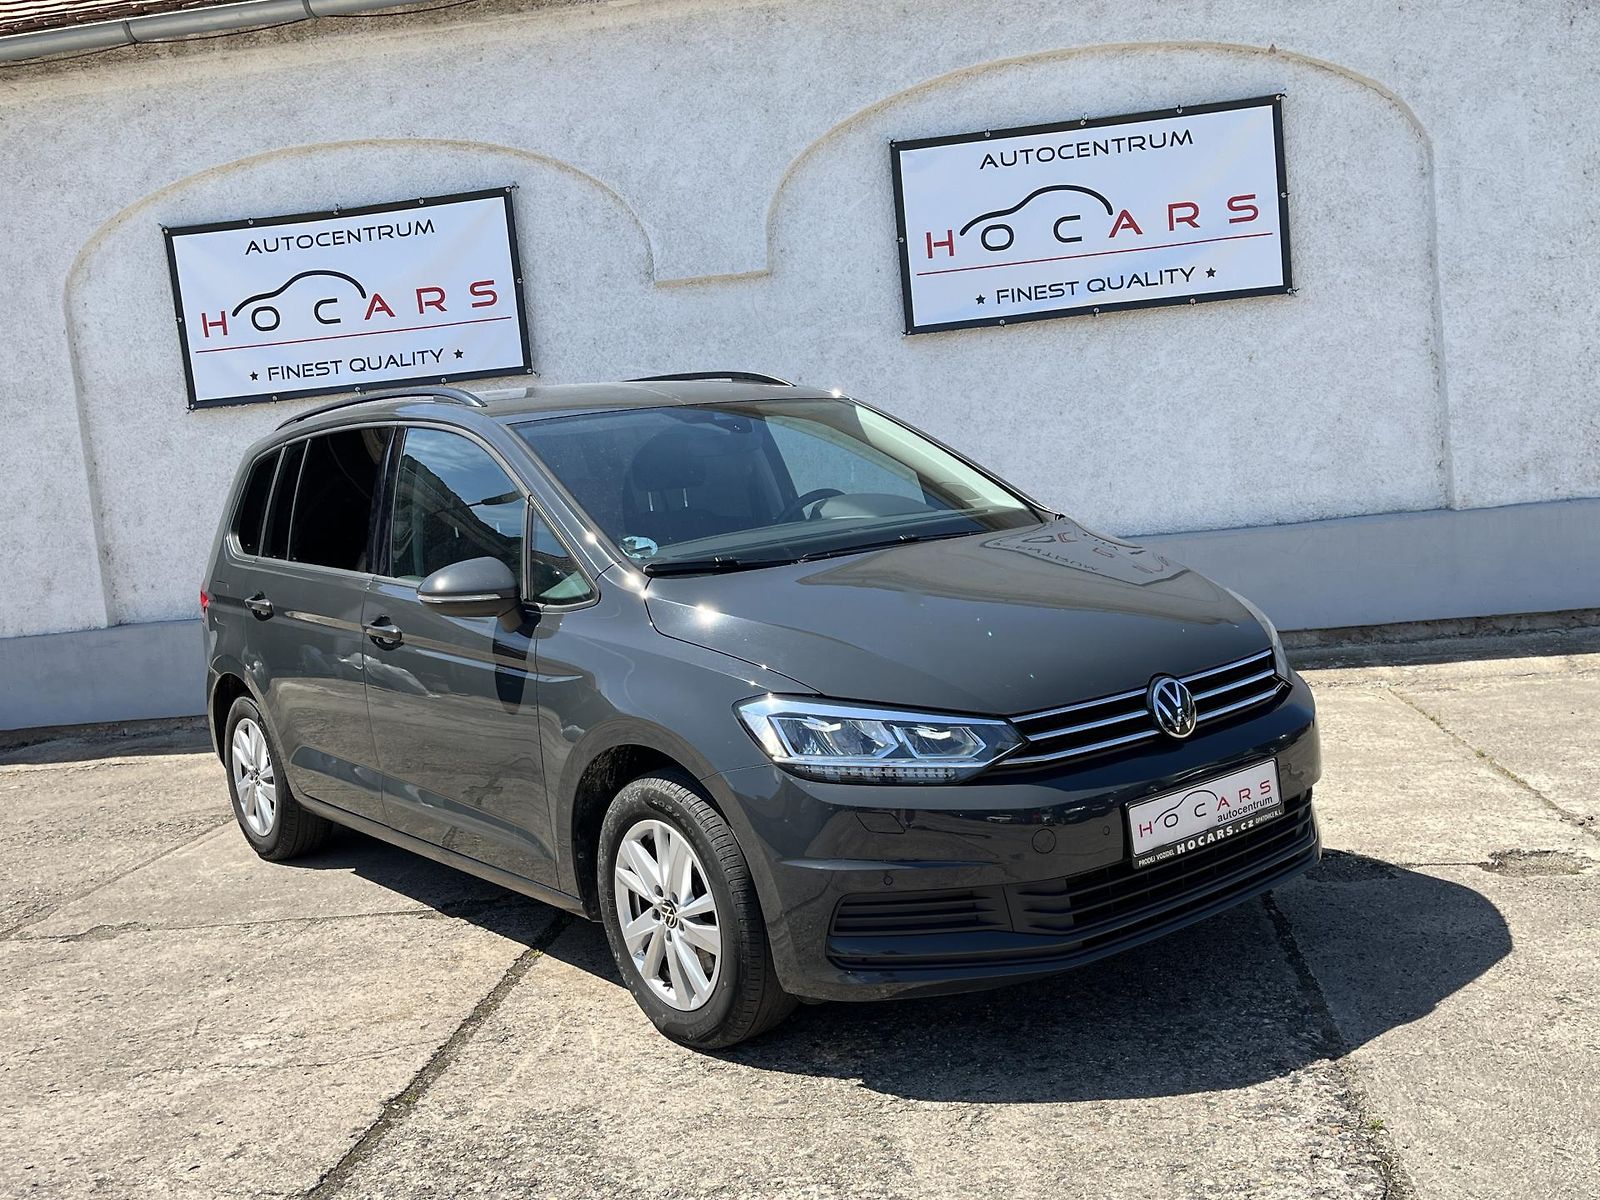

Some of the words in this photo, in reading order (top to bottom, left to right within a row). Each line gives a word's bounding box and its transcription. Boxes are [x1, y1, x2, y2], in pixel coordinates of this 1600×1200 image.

[979, 128, 1194, 170] AUTOCENTRUM
[245, 218, 436, 256] AUTOCENTRUM
[925, 193, 1259, 259] HOCARS
[996, 280, 1080, 305] FINEST
[1086, 266, 1197, 293] QUALITY
[201, 279, 499, 339] HOCARS
[267, 358, 343, 382] FINEST
[349, 347, 446, 373] QUALITY
[1138, 779, 1272, 838] HOCARS
[1217, 796, 1274, 823] autocentrum
